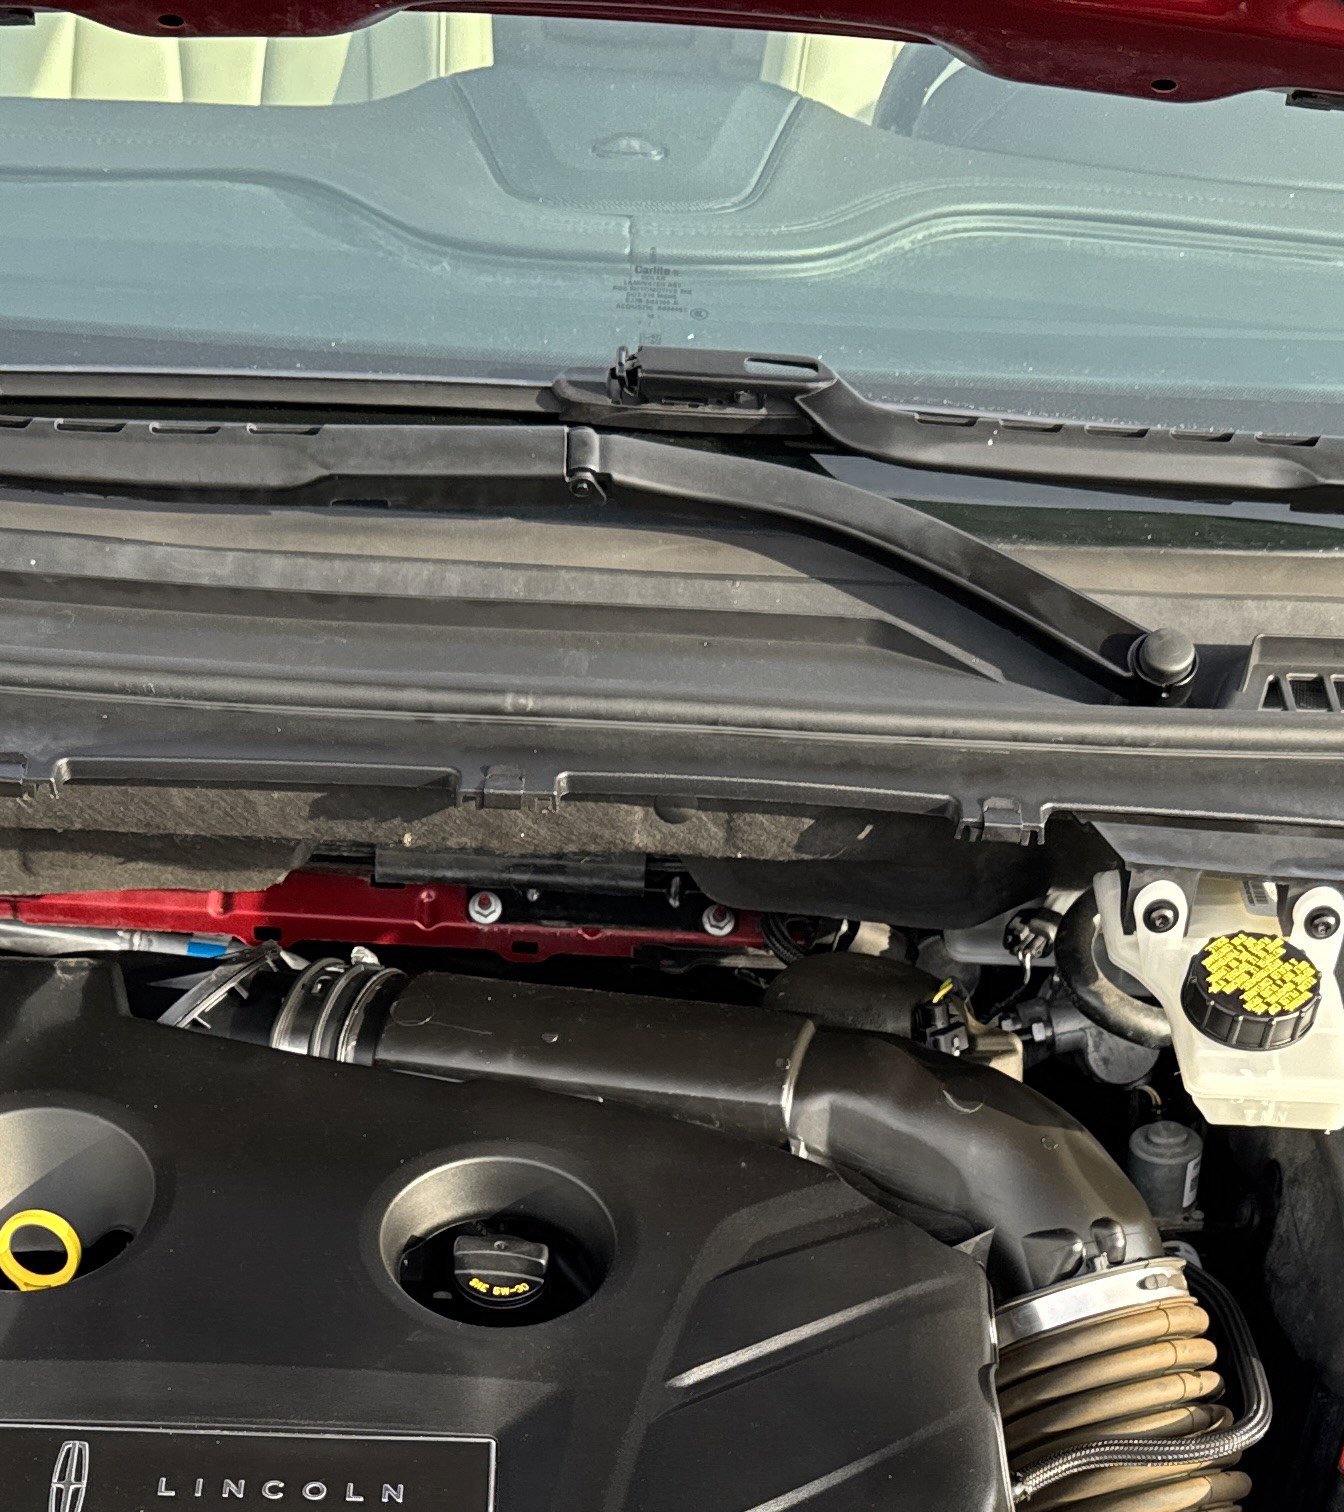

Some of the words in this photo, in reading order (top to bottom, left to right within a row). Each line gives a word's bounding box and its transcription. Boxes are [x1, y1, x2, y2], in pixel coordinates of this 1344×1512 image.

[469, 1278, 490, 1293] SAE
[492, 1283, 530, 1296] 5W-30
[157, 1475, 404, 1504] LINCOLN
